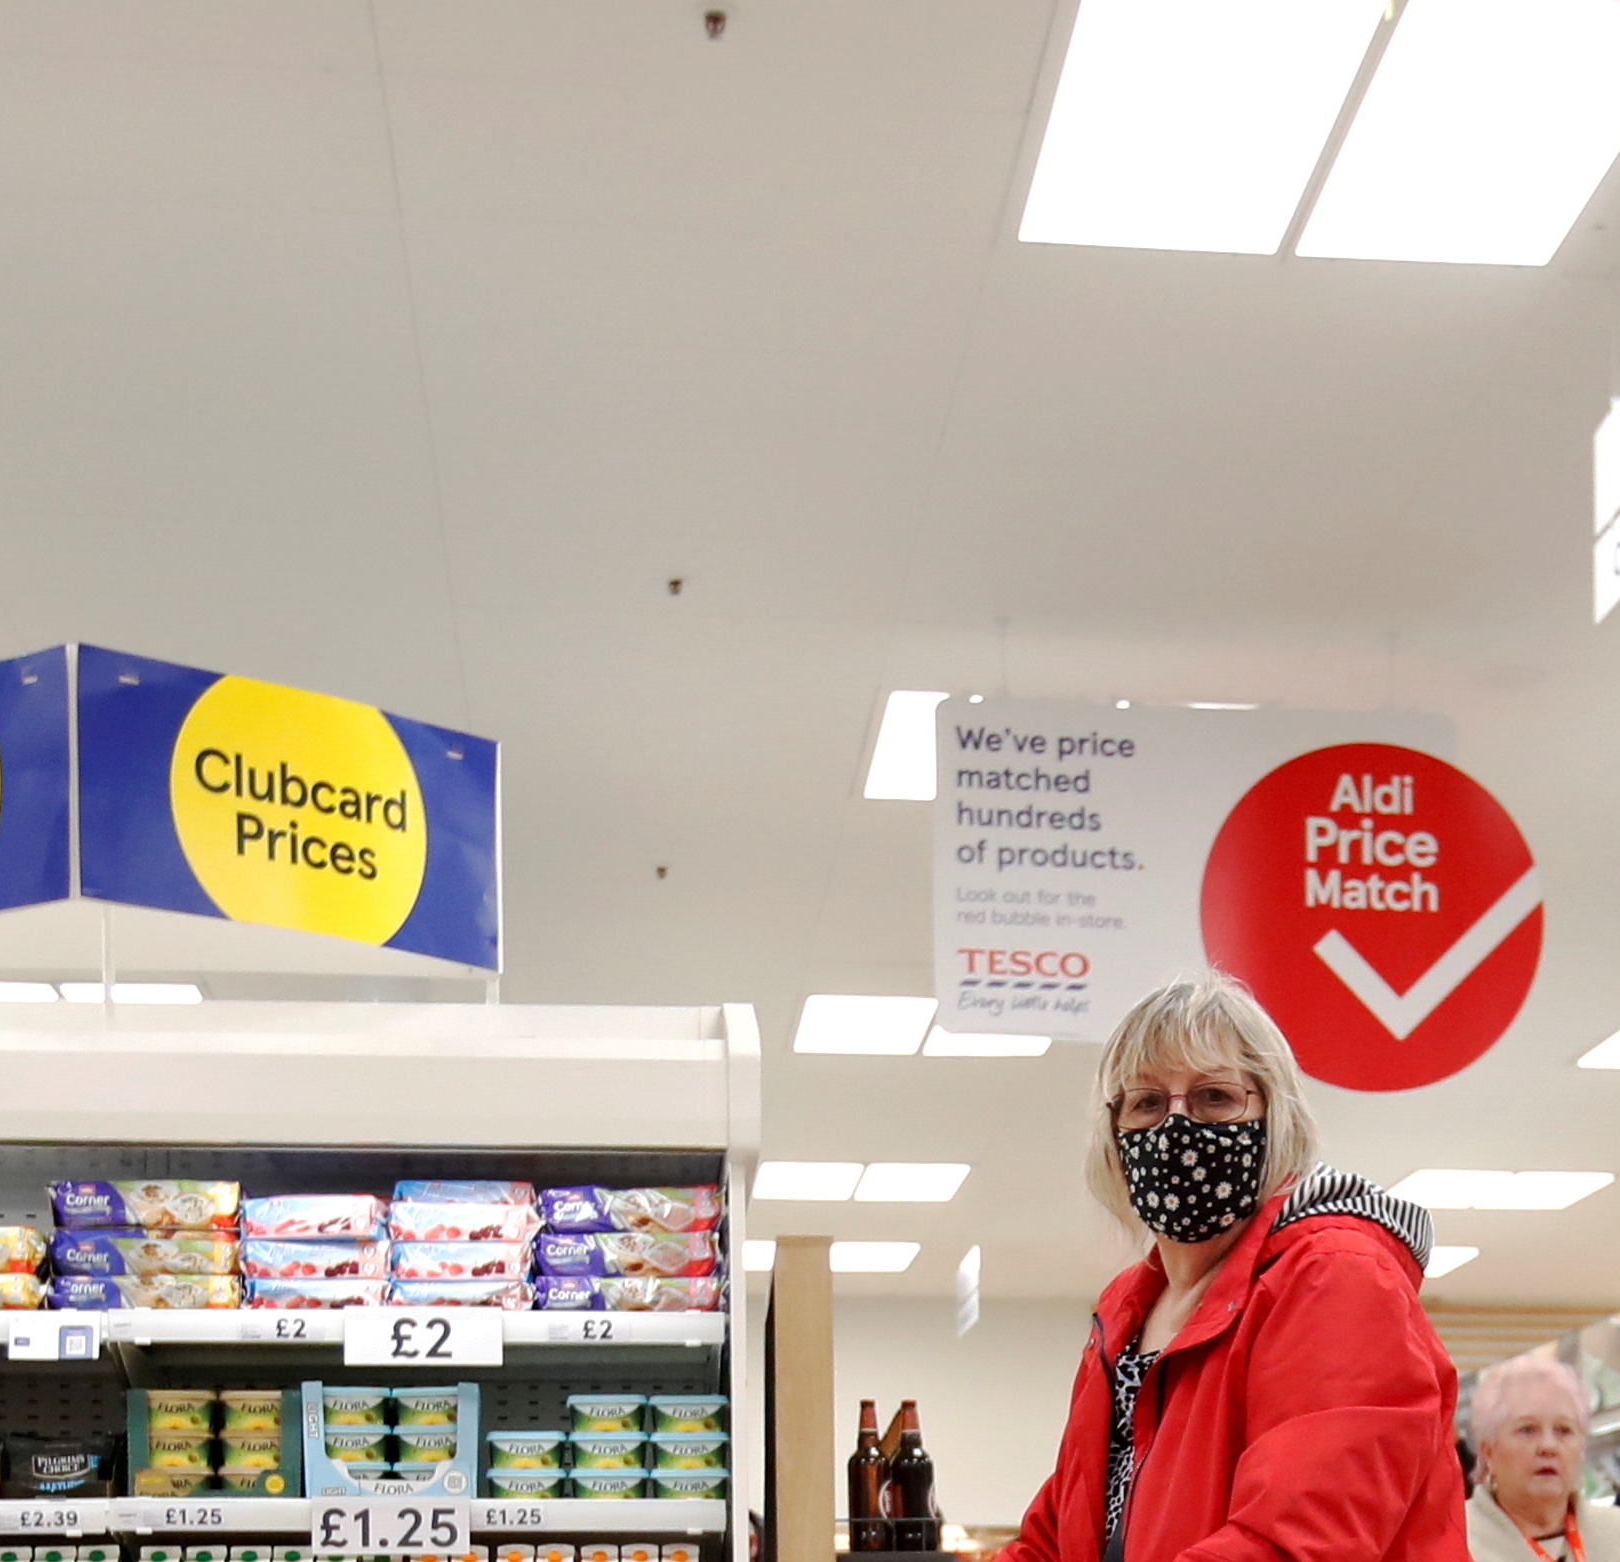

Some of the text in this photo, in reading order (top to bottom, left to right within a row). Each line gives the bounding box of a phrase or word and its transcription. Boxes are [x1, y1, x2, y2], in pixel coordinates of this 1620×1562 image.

[1057, 732, 1136, 760] price
[957, 764, 1090, 794] matched
[194, 746, 409, 834] Clubcard
[1329, 774, 1414, 815] Aldi
[957, 802, 1102, 832] hundreds
[235, 813, 379, 880] Prices
[1304, 818, 1439, 867] Price
[957, 840, 1145, 873] of products.
[957, 887, 1096, 908] Look out for the
[1304, 870, 1439, 912] Match
[957, 908, 1127, 931] red bubble in-store.
[959, 949, 1089, 978] TESCO
[65, 1192, 110, 1208] Corner
[66, 1248, 109, 1264] Corner
[545, 1243, 590, 1259] Corner
[548, 1287, 592, 1303] Corner
[276, 1318, 307, 1340] £2
[391, 1316, 454, 1360] £2
[583, 1319, 613, 1340] £2
[306, 1403, 321, 1440] LIGHT
[155, 1439, 192, 1452] FLORA
[241, 1440, 278, 1452] FLORA
[509, 1442, 545, 1455] FLORA
[591, 1443, 628, 1454] FLORA
[673, 1443, 710, 1454] FLORA
[374, 1481, 415, 1496] FLORA
[20, 1511, 79, 1527] £2.39
[165, 1508, 223, 1526] £1.25
[486, 1508, 542, 1526] £1.25
[320, 1507, 459, 1549] £1.25
